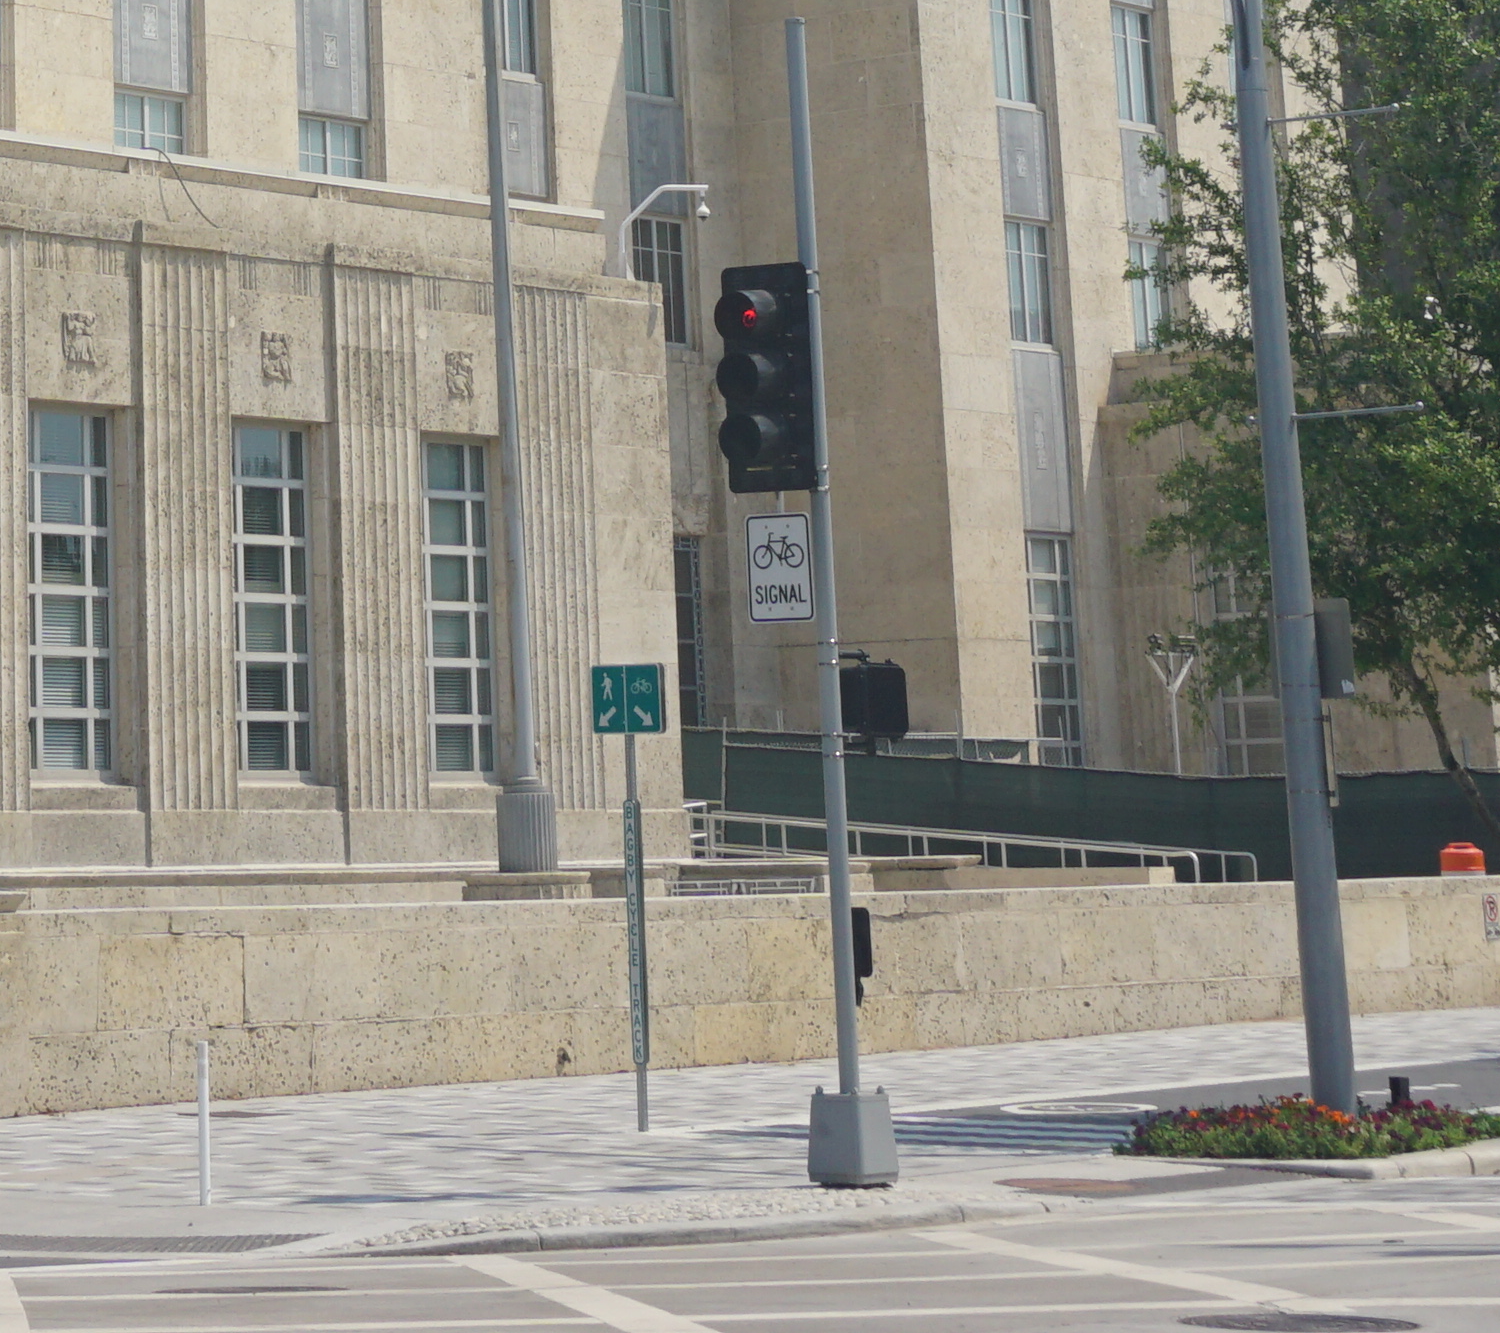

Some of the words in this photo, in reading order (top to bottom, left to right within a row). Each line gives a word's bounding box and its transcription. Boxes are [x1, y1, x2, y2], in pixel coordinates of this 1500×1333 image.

[755, 583, 807, 604] SIGNAL
[625, 806, 635, 882] BAGBY
[629, 893, 638, 967] CYCLE
[633, 984, 642, 1059] TRACK
